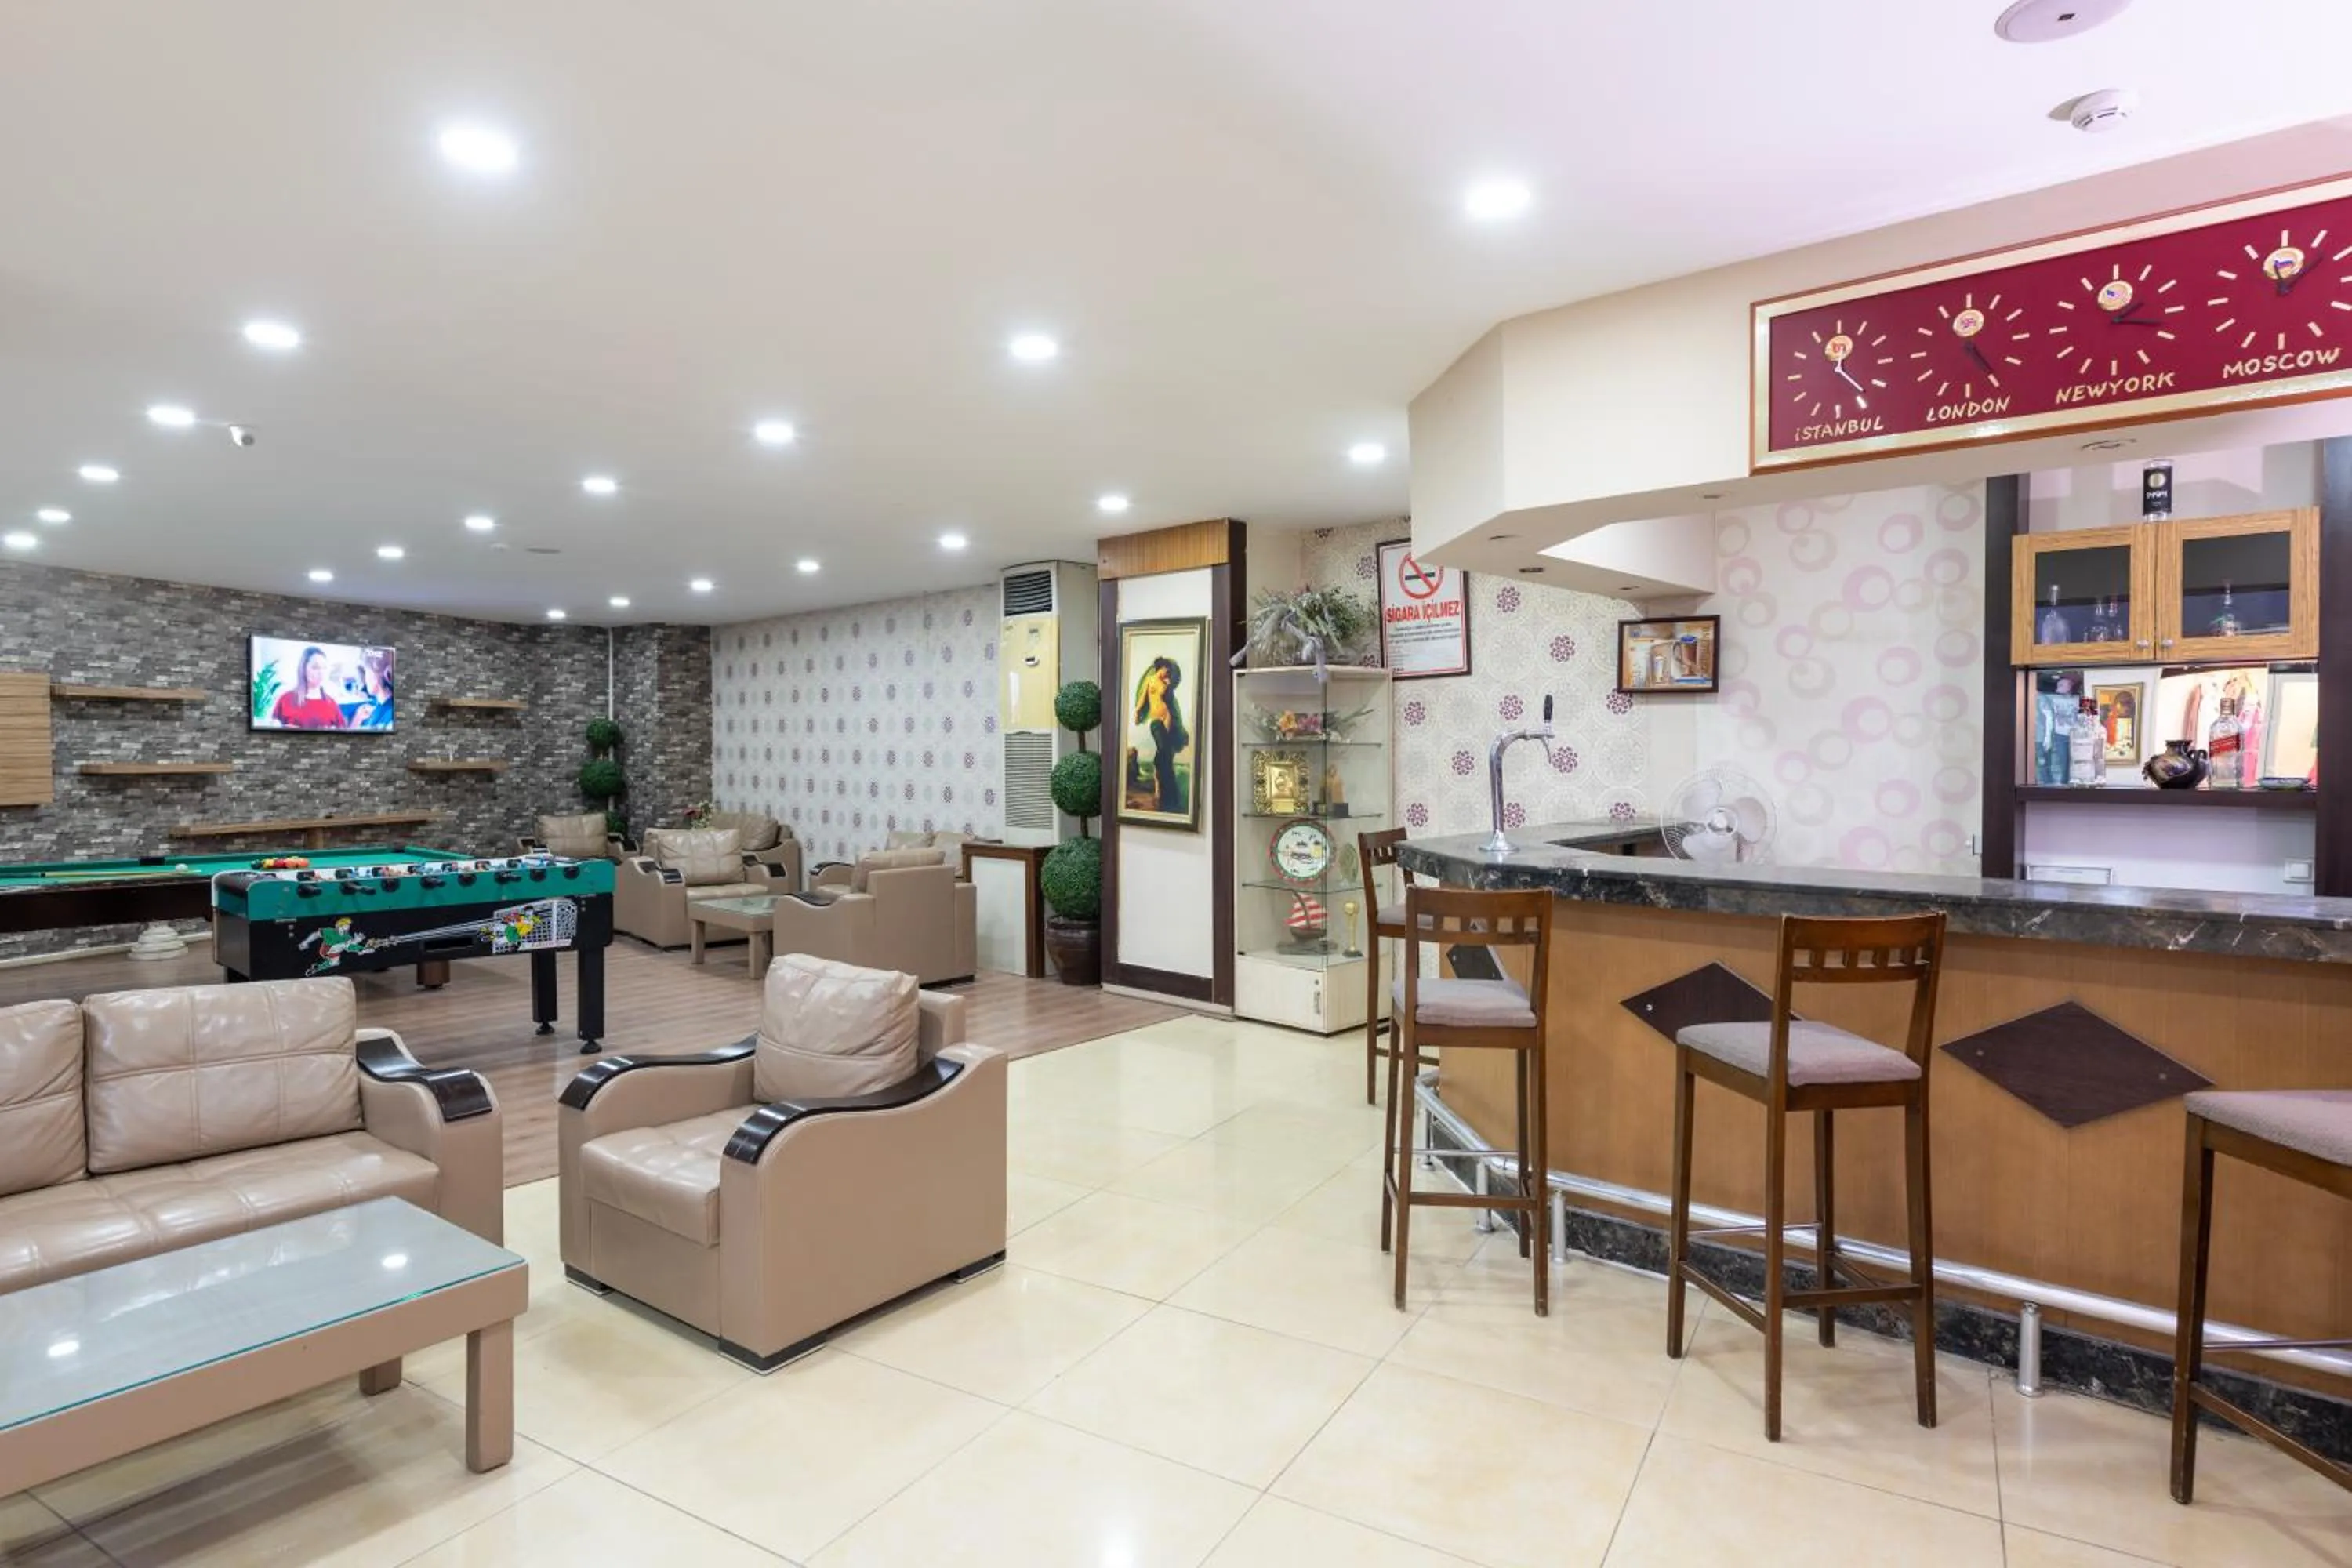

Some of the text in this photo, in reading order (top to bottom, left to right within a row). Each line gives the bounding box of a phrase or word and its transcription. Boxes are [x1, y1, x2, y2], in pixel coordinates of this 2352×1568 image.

[2222, 347, 2340, 378] MOSCOW
[2055, 372, 2175, 404] NEWYORK
[1926, 394, 2011, 422] LONDON
